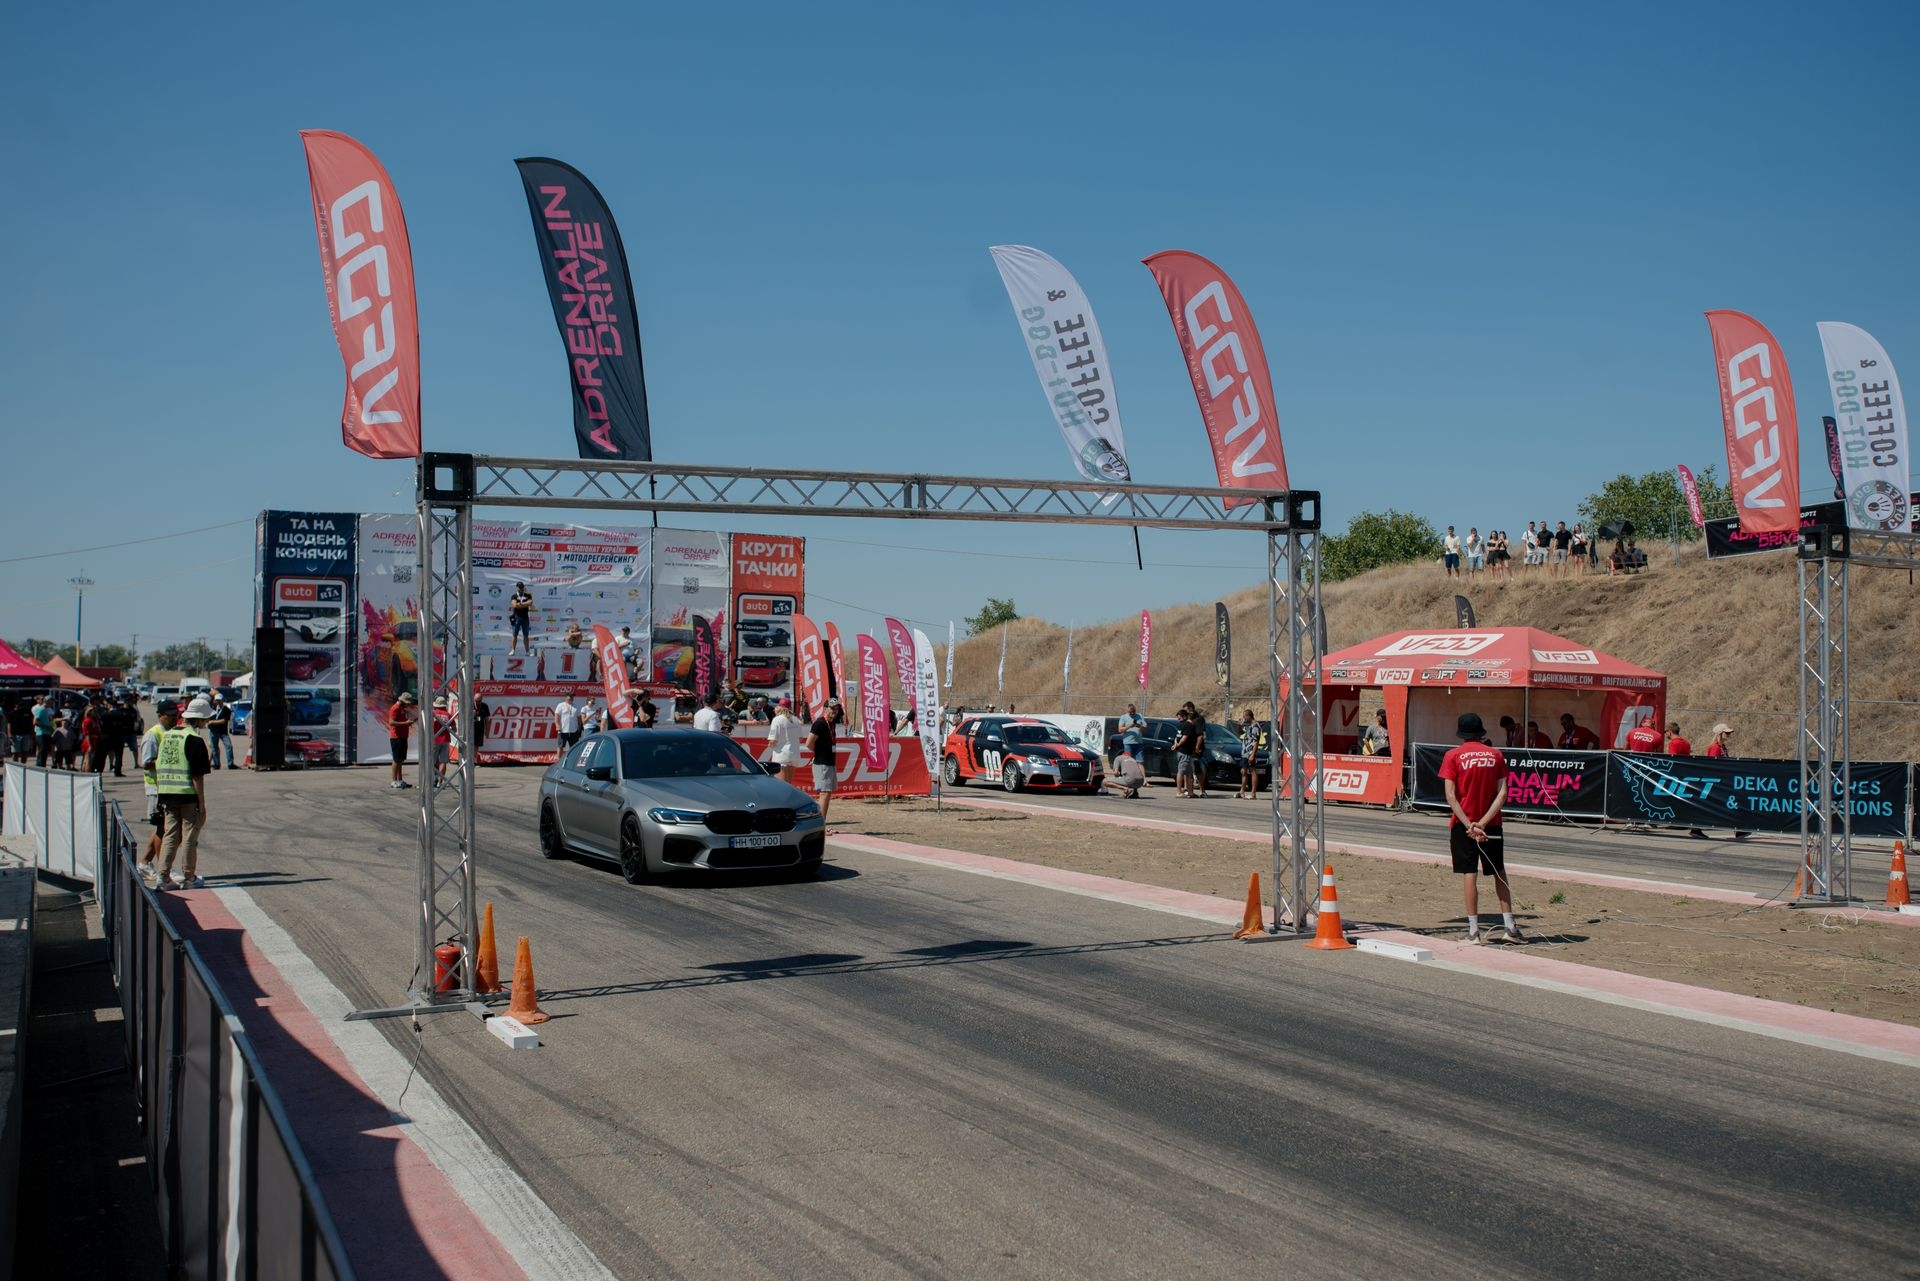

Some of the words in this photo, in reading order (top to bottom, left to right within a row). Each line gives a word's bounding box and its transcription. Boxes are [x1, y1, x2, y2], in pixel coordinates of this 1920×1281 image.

[574, 222, 624, 356] DRIVE
[539, 185, 619, 453] ADRENALIN
[290, 518, 308, 531] ТА
[313, 519, 335, 531] НА
[278, 532, 347, 547] ЩОДЕНЬ
[275, 547, 348, 561] КОНЯЧКИ
[664, 546, 719, 556] ADRENALIN
[742, 541, 794, 559] КРУТІ
[564, 553, 637, 563] МОТОДРЕГРЕЙСИНГУ
[737, 560, 797, 577] ТАЧКИ
[284, 586, 313, 597] auto
[319, 587, 341, 600] RIA
[746, 602, 768, 612] auto
[774, 602, 791, 614] RIA
[1399, 637, 1485, 650] VFDD
[561, 652, 575, 673] 1
[1538, 652, 1592, 662] VFDD
[506, 658, 525, 673] 2
[1331, 669, 1346, 679] PRO
[1380, 670, 1411, 681] VFDD
[1467, 669, 1486, 679] PRO
[1533, 673, 1593, 685] DRAGUKRAINE.COM
[1602, 676, 1662, 688] DRIFTUKRAINE.COM
[874, 663, 883, 722] DRIVE
[863, 645, 877, 762] ADRENALIN
[492, 706, 556, 718] ADREN
[488, 719, 557, 739] DRIFT
[1460, 751, 1495, 761] OFFICIAL
[1461, 758, 1496, 770] VFDD
[1508, 771, 1582, 790] NALIN
[1733, 775, 1778, 792] DEKA
[1507, 788, 1559, 806] RIVE
[1726, 796, 1739, 811] &
